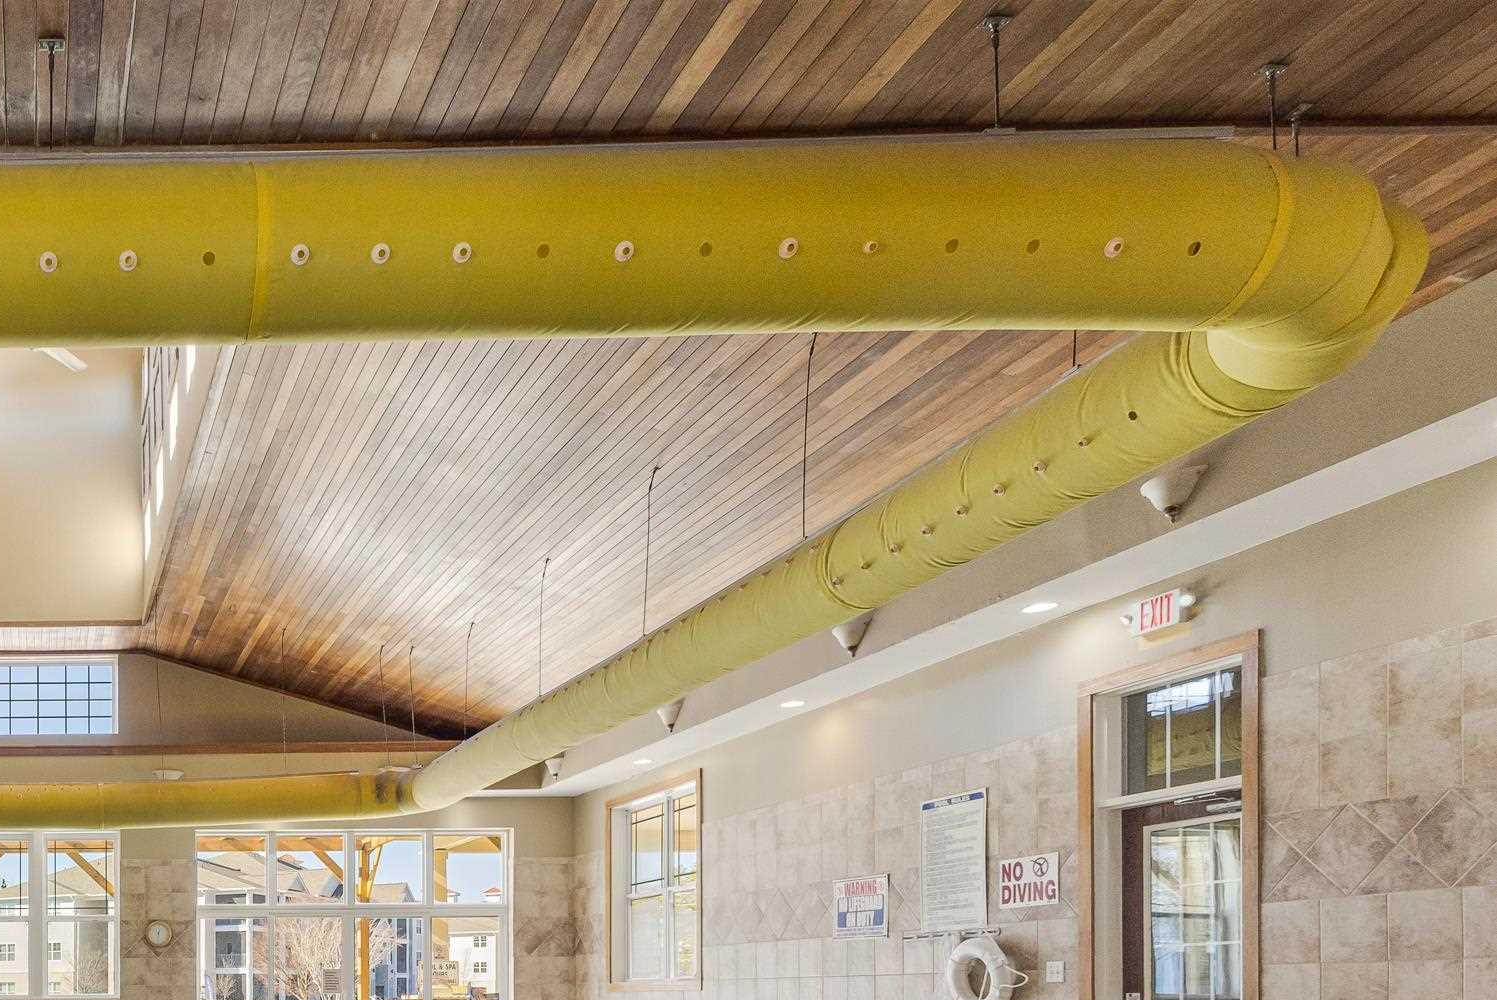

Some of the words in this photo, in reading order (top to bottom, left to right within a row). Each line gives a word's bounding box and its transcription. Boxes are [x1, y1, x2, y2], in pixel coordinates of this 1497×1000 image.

[1140, 592, 1174, 632] EXIT
[1002, 862, 1023, 882] NO
[844, 880, 877, 897] WARNING
[1002, 880, 1056, 904] DIVING
